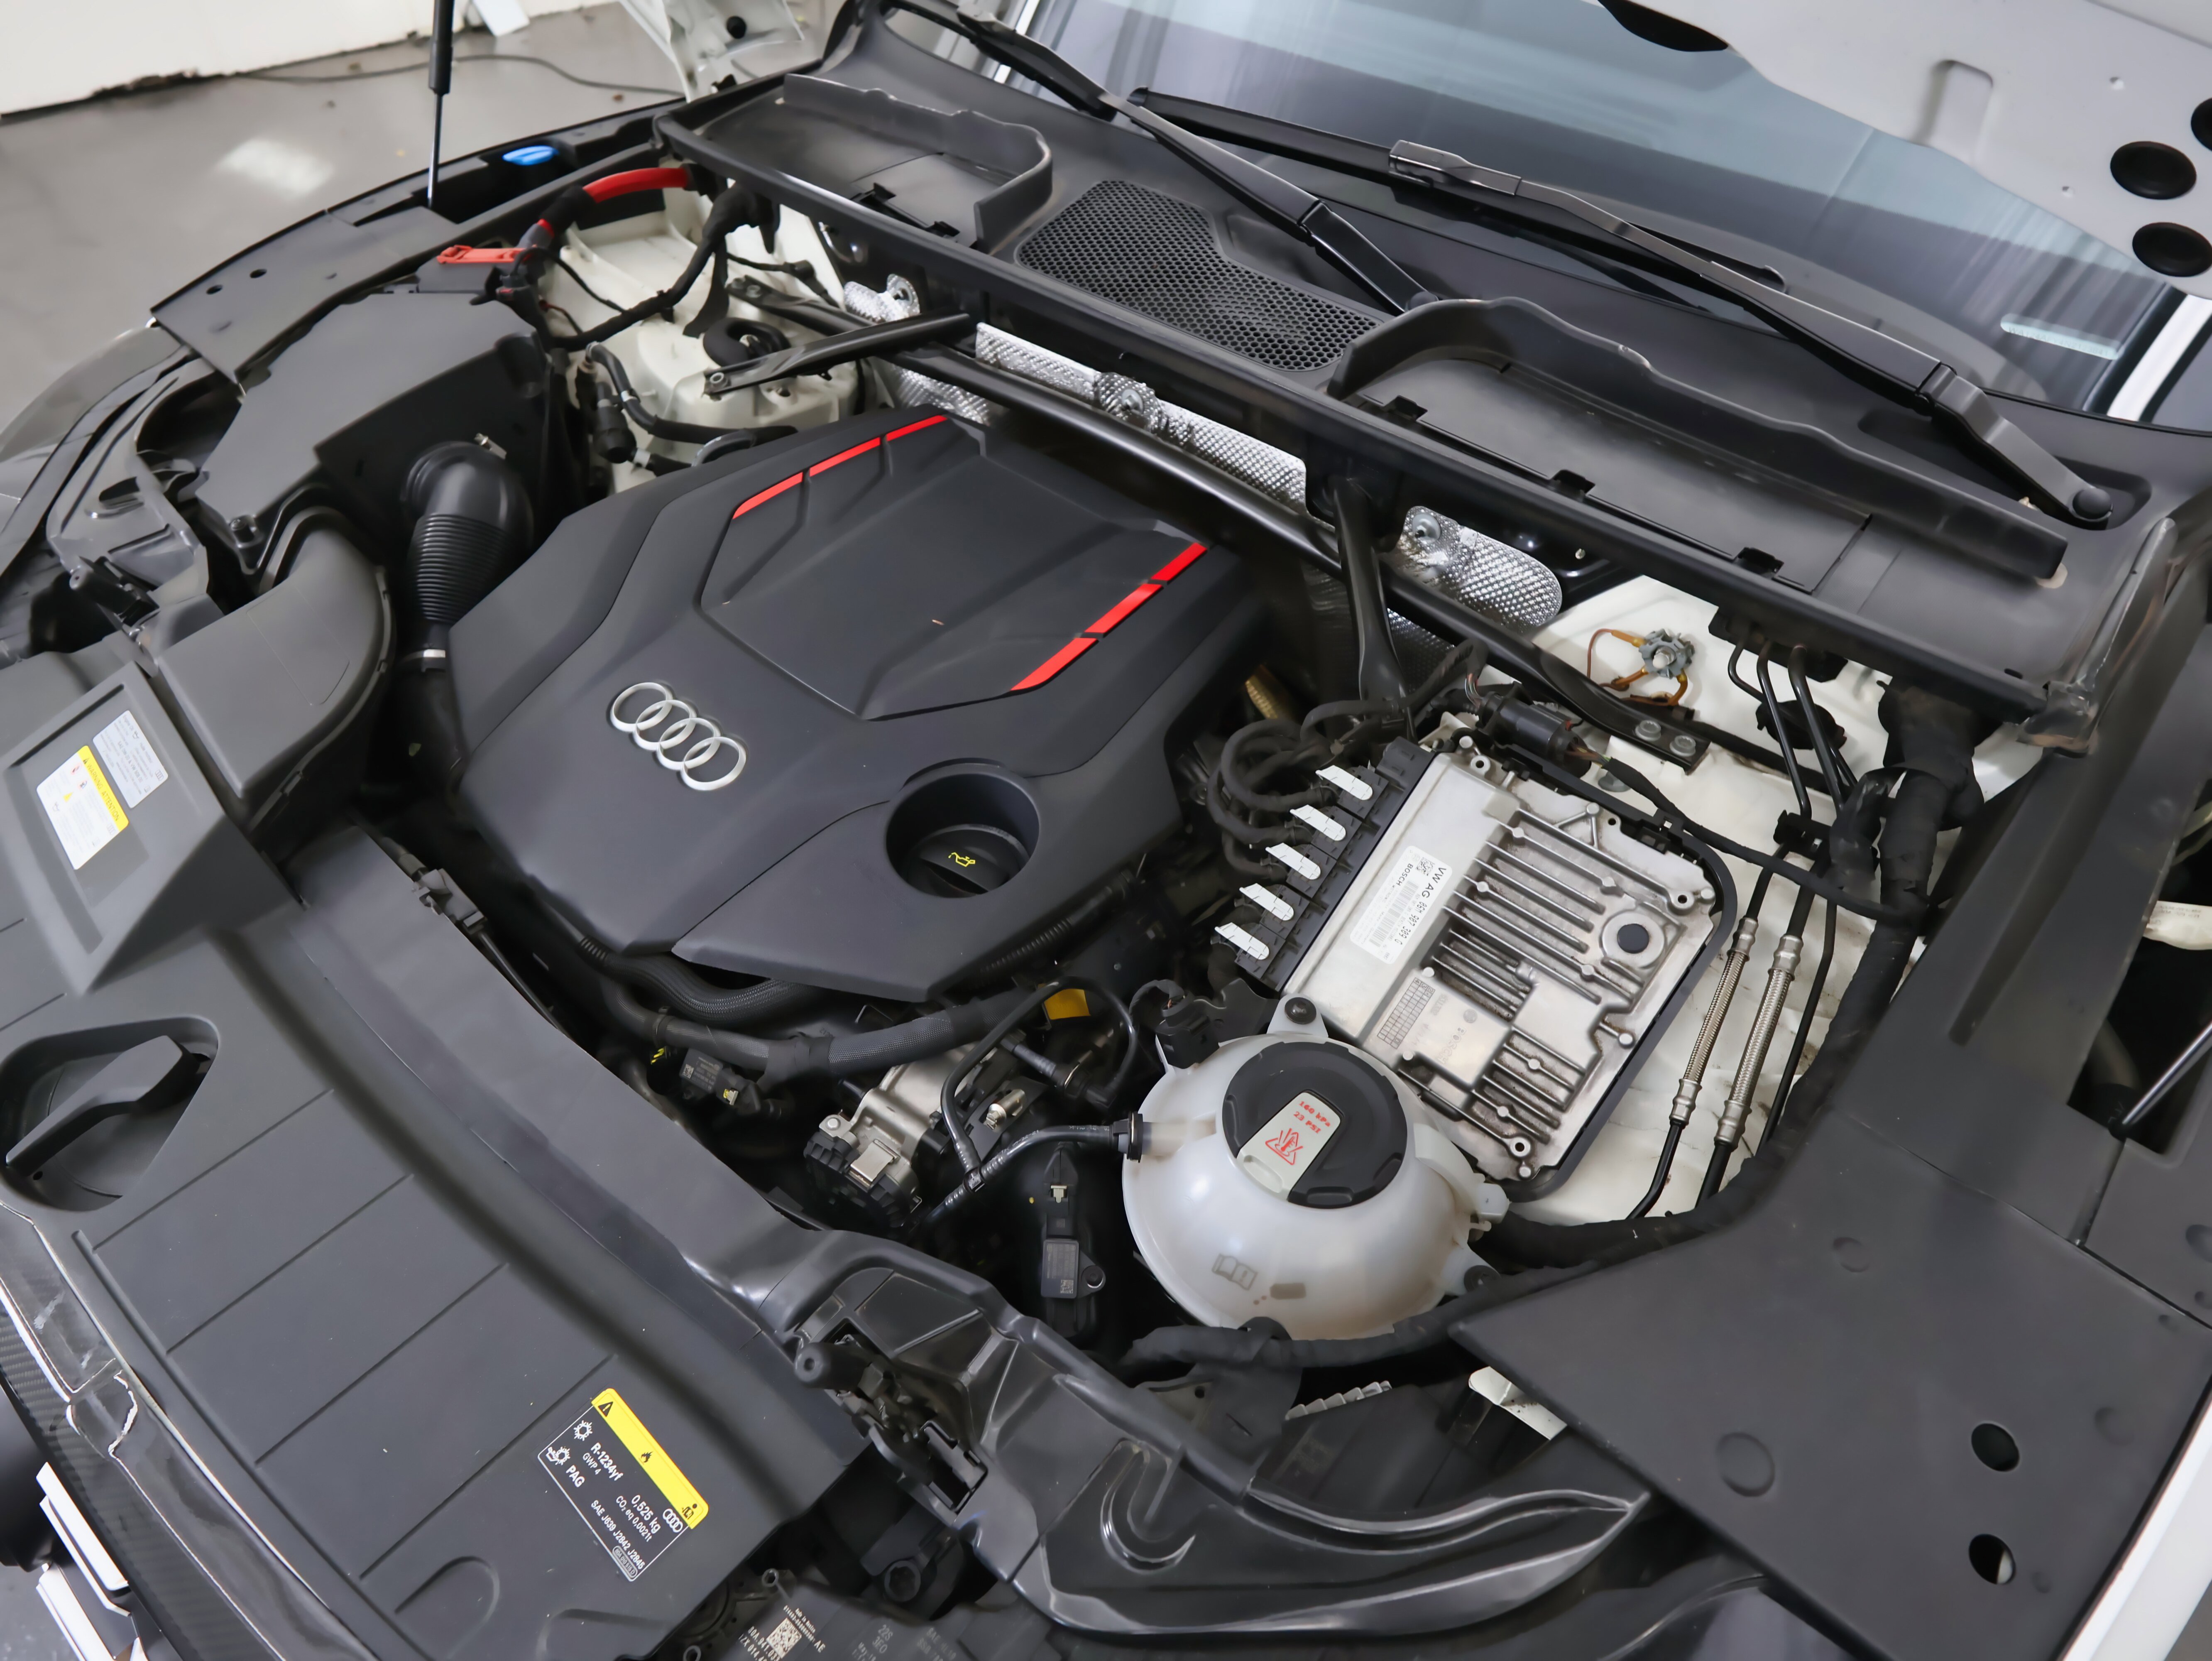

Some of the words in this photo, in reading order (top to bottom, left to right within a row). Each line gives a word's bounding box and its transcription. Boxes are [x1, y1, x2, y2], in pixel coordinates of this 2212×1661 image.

[87, 763, 103, 789] WARNING
[101, 791, 120, 821] ATTENTION
[1396, 863, 1414, 886] BOSCH
[1432, 867, 1446, 883] VW
[1422, 884, 1434, 899] AG
[1409, 914, 1419, 926] 907
[1401, 926, 1411, 939] 309
[1438, 1027, 1466, 1064] BOSCH
[1293, 1111, 1305, 1122] 23
[1306, 1120, 1321, 1134] PSI
[1299, 1101, 1314, 1115] 160
[1316, 1112, 1331, 1127] kPa
[582, 1453, 598, 1470] GWP
[590, 1442, 624, 1481] R-1234yf
[566, 1465, 585, 1488] PAG
[625, 1509, 634, 1521] eq
[631, 1495, 655, 1521] 0,525
[649, 1517, 661, 1534] kg
[591, 1500, 605, 1516] SAE
[602, 1514, 617, 1532] J639
[613, 1530, 630, 1551] J2842
[627, 1549, 646, 1570] J2845
[814, 1640, 826, 1653] AE
